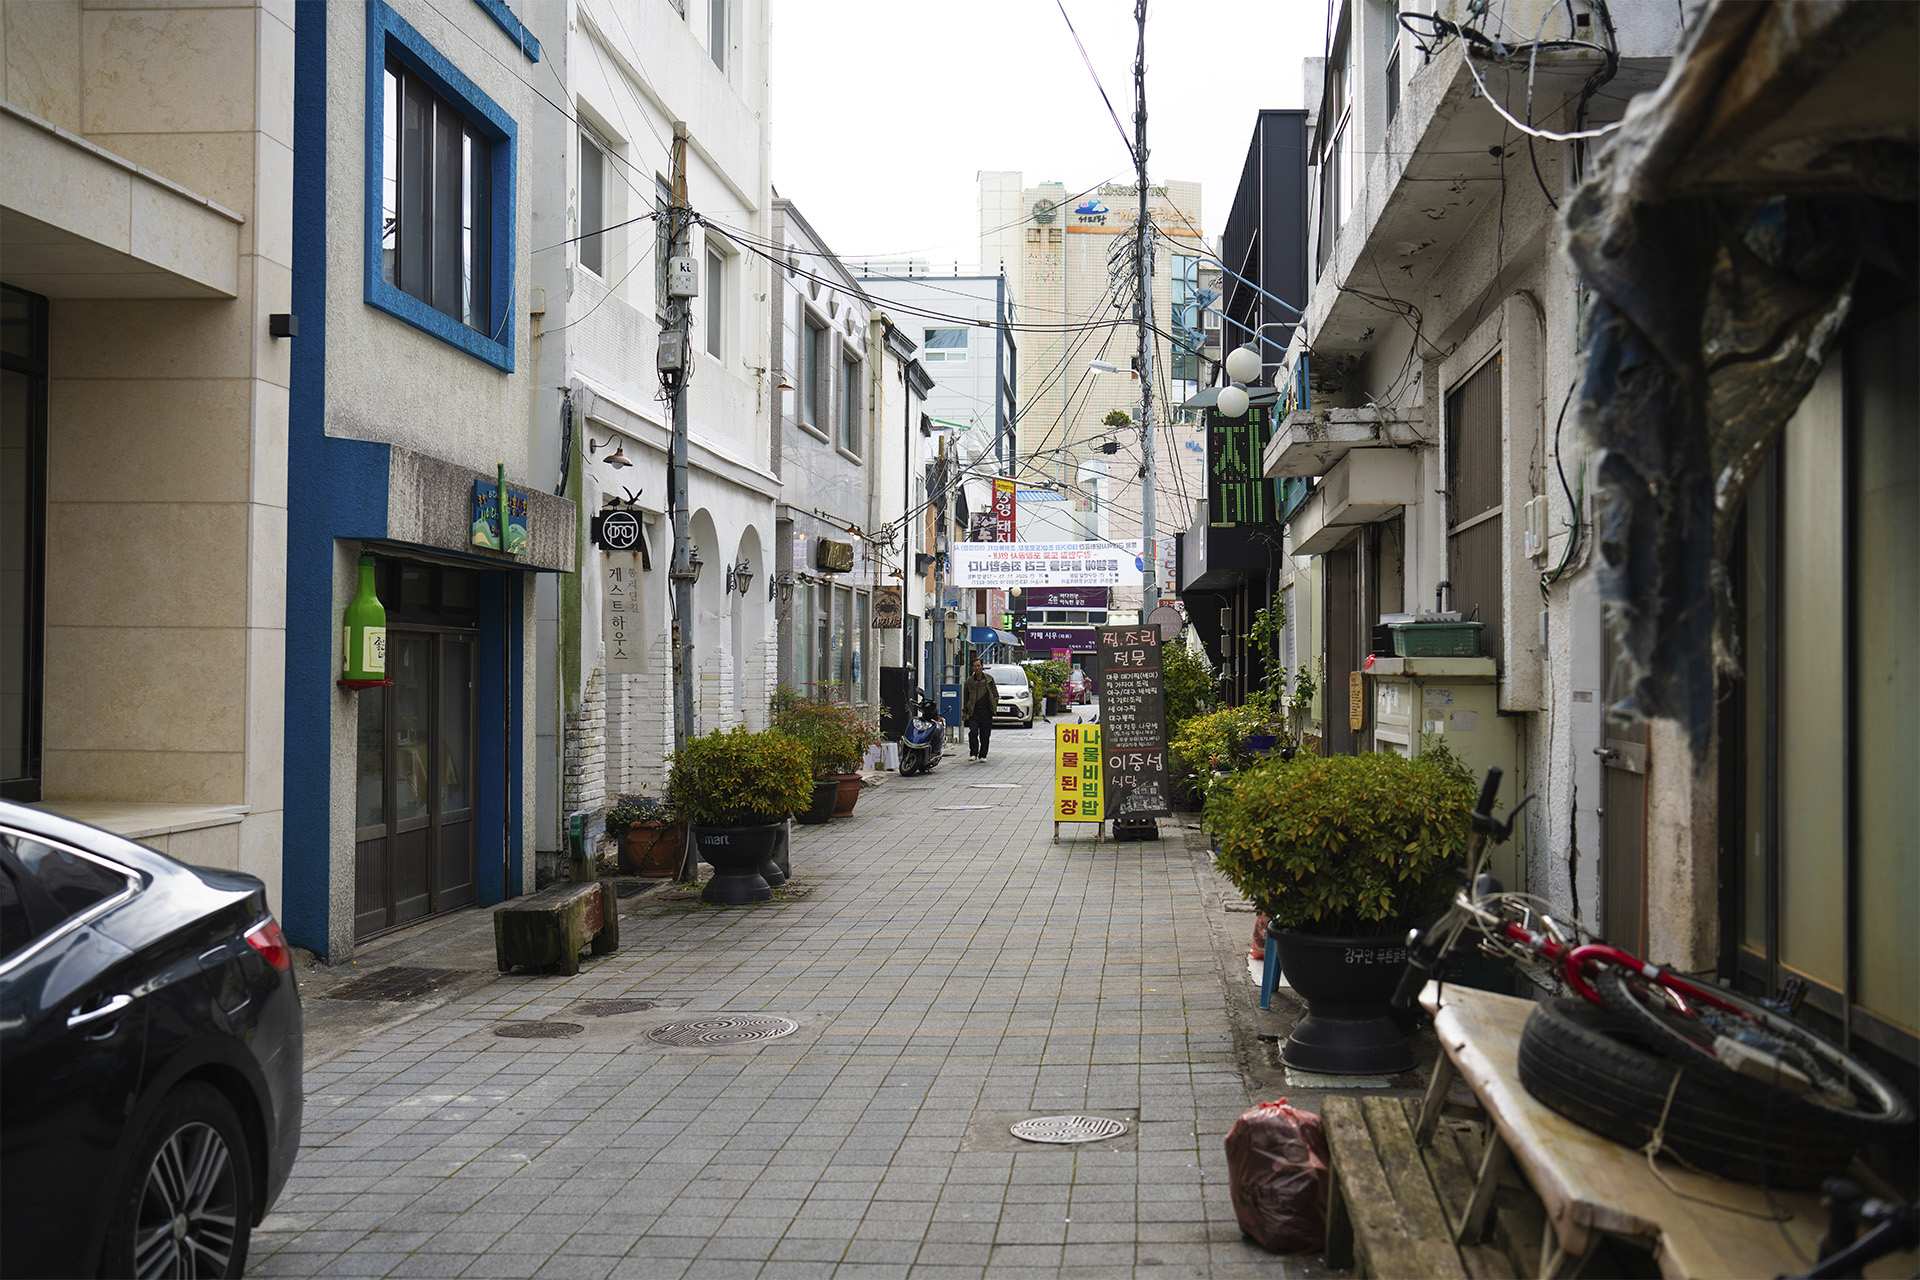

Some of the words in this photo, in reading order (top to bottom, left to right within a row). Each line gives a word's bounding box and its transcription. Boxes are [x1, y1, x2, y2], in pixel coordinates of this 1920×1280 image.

[609, 567, 628, 660] 게스트하우스
[1030, 631, 1043, 640] 카페
[1045, 631, 1057, 640] 시우
[1113, 650, 1146, 667] 전문
[1109, 753, 1163, 771] 이중섭
[1060, 729, 1079, 815] 해물된장
[1082, 729, 1100, 816] 나물비빔밥
[1111, 775, 1138, 788] 식당
[1345, 947, 1374, 964] 강구안
